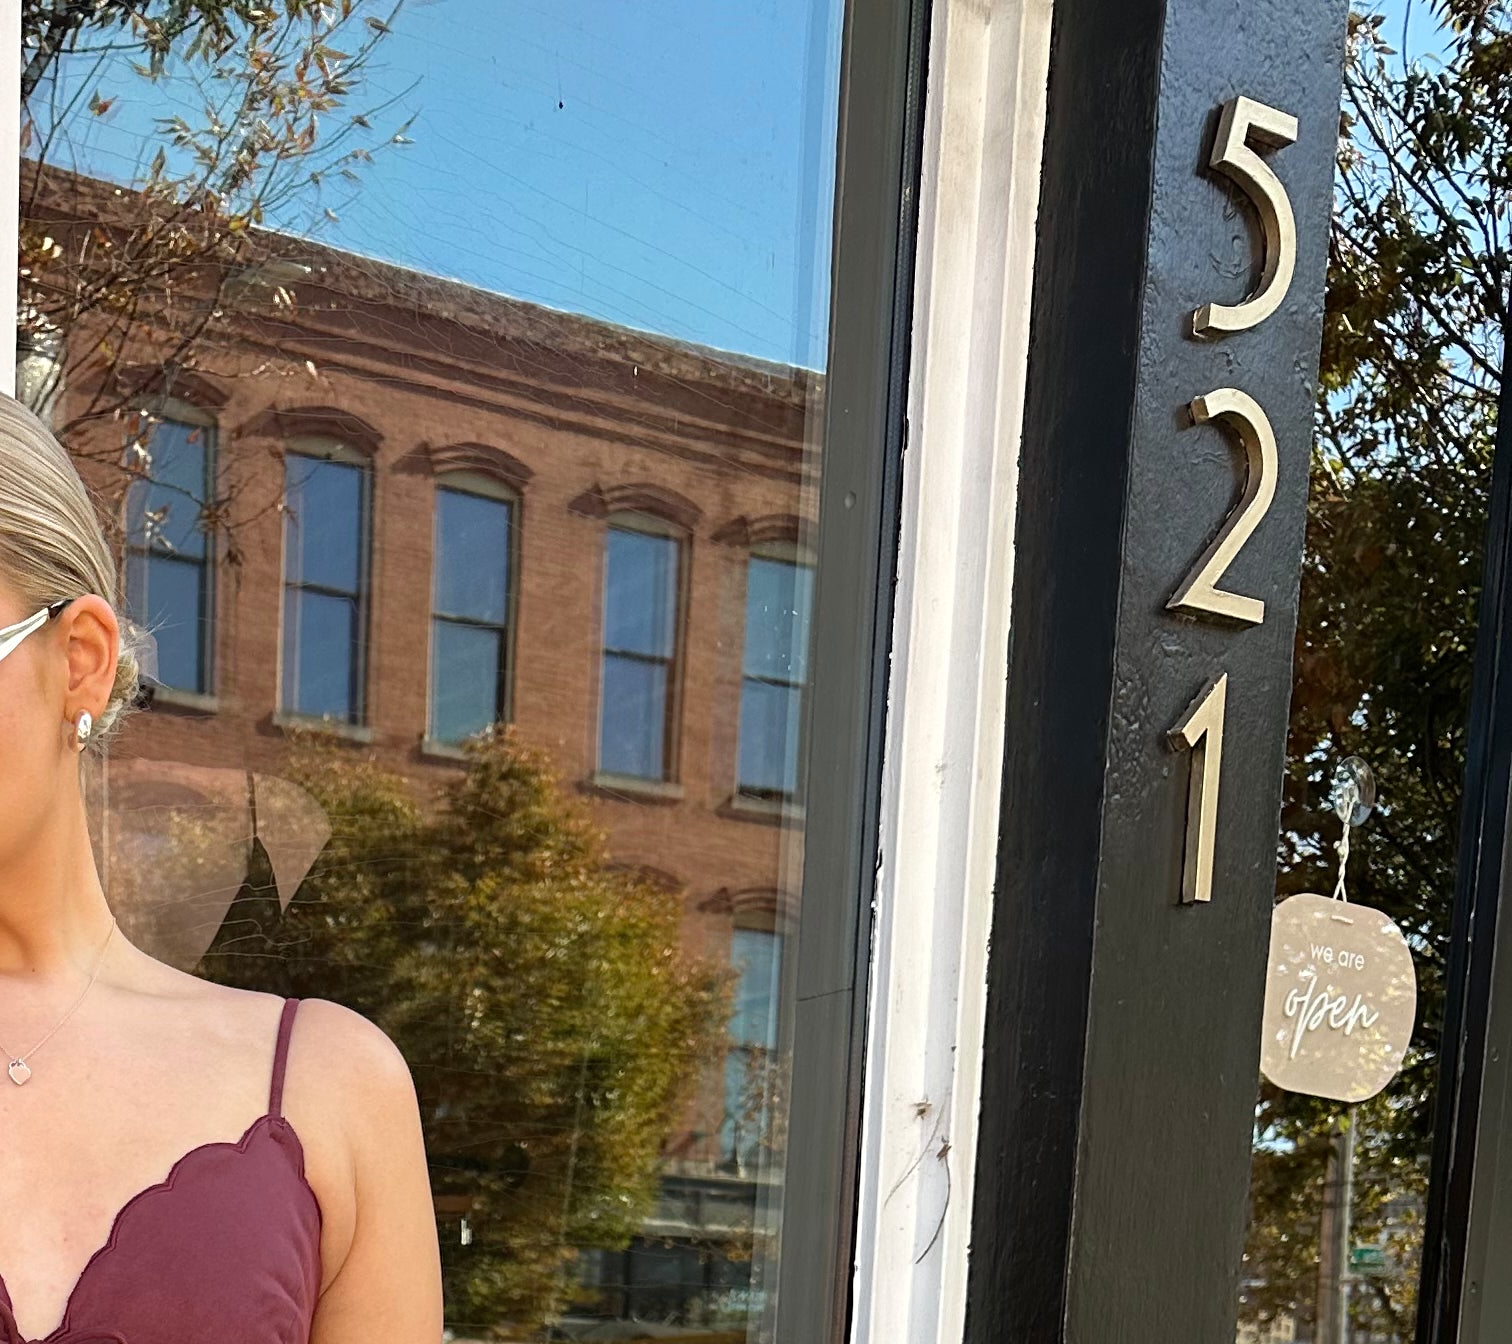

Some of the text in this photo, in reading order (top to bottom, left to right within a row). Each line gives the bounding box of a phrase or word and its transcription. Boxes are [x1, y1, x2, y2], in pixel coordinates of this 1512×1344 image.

[1167, 95, 1298, 903] 521
[1310, 943, 1365, 971] we are
[1284, 975, 1379, 1060] open
